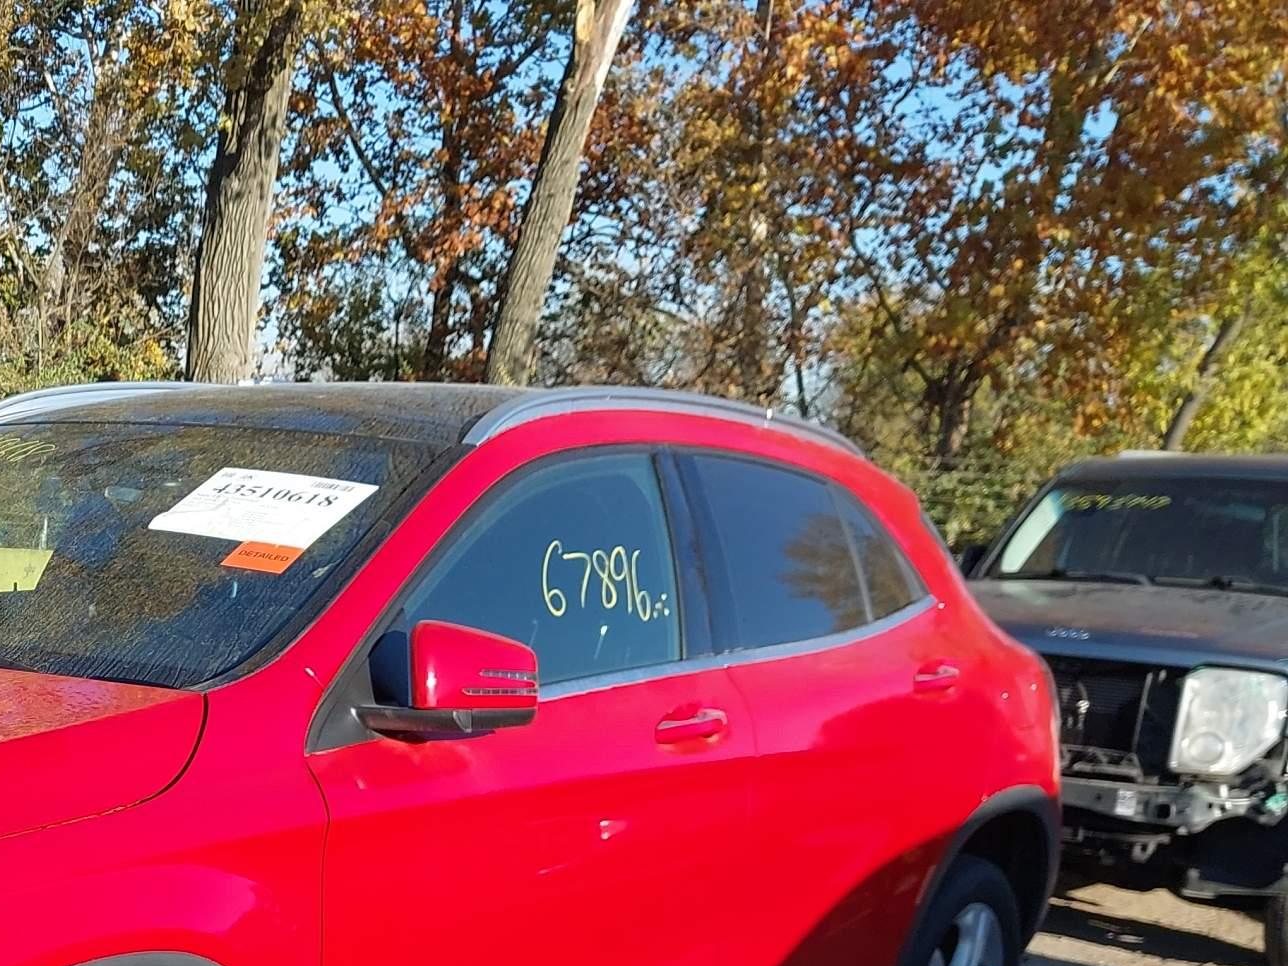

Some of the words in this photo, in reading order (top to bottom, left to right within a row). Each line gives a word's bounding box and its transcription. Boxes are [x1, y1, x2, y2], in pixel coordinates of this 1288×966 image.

[213, 482, 339, 507] 43510618
[238, 549, 289, 563] DETAILED
[542, 540, 651, 621] 67896
